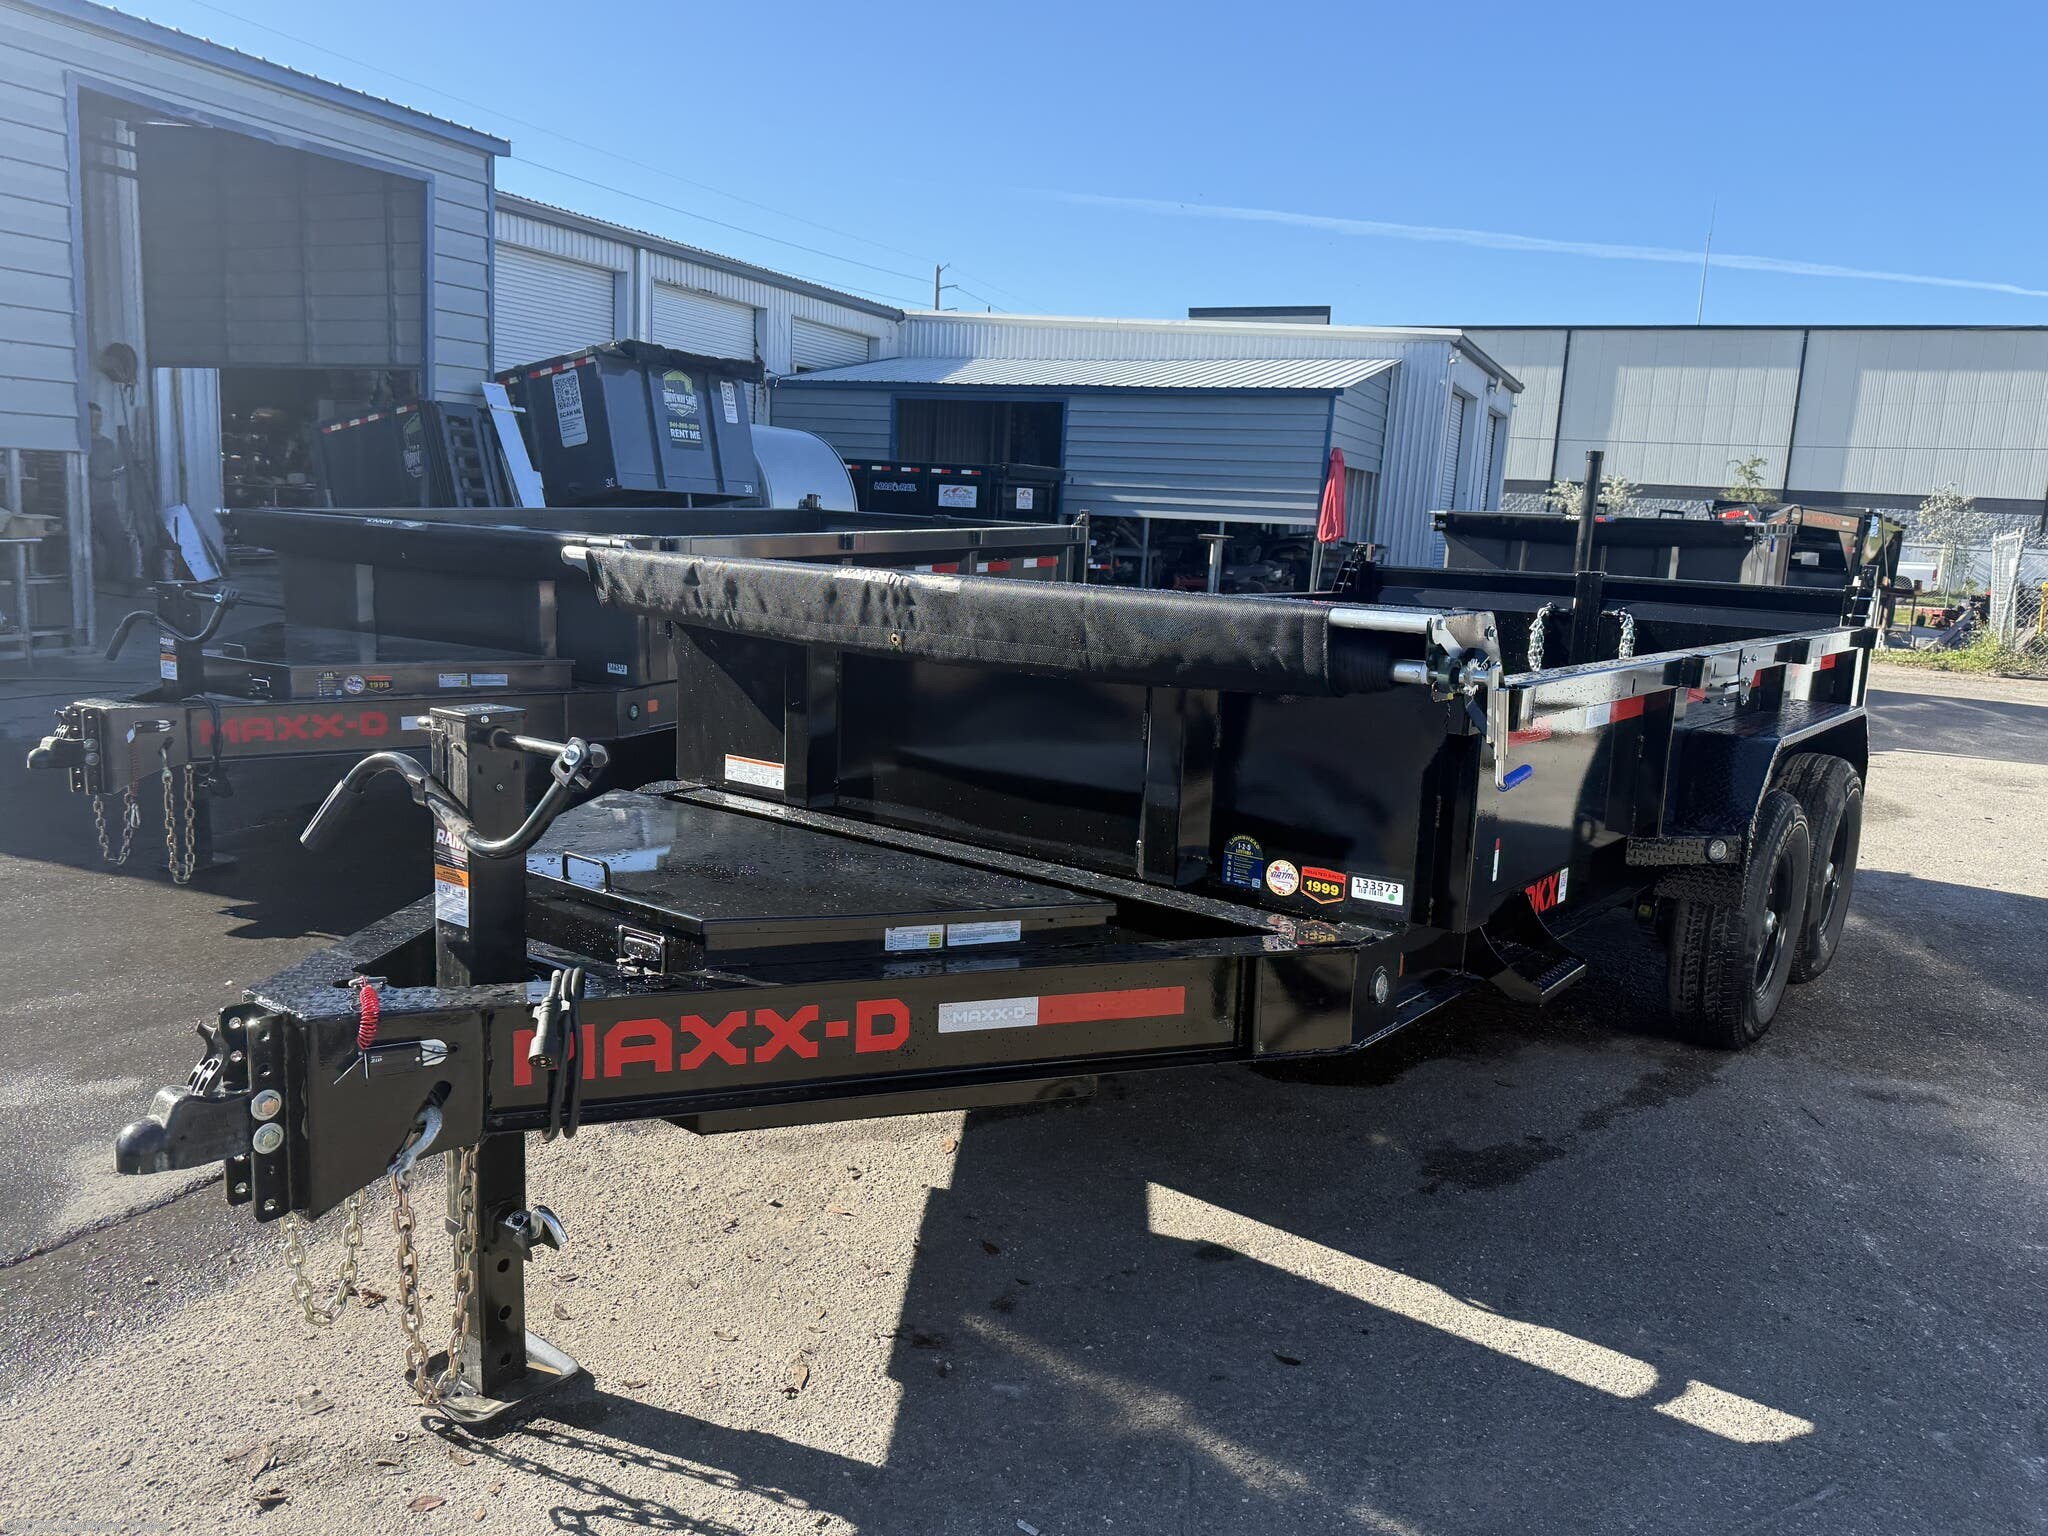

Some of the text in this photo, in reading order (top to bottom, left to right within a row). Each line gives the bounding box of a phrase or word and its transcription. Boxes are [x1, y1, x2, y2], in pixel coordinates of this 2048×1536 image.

[560, 407, 582, 418] SCAN ME
[670, 429, 702, 440] RENT ME
[744, 484, 753, 494] 30
[198, 711, 389, 745] MAXX-D
[1306, 880, 1339, 896] 1999
[1355, 878, 1399, 894] 133573
[952, 1006, 1026, 1024] MAXX-D
